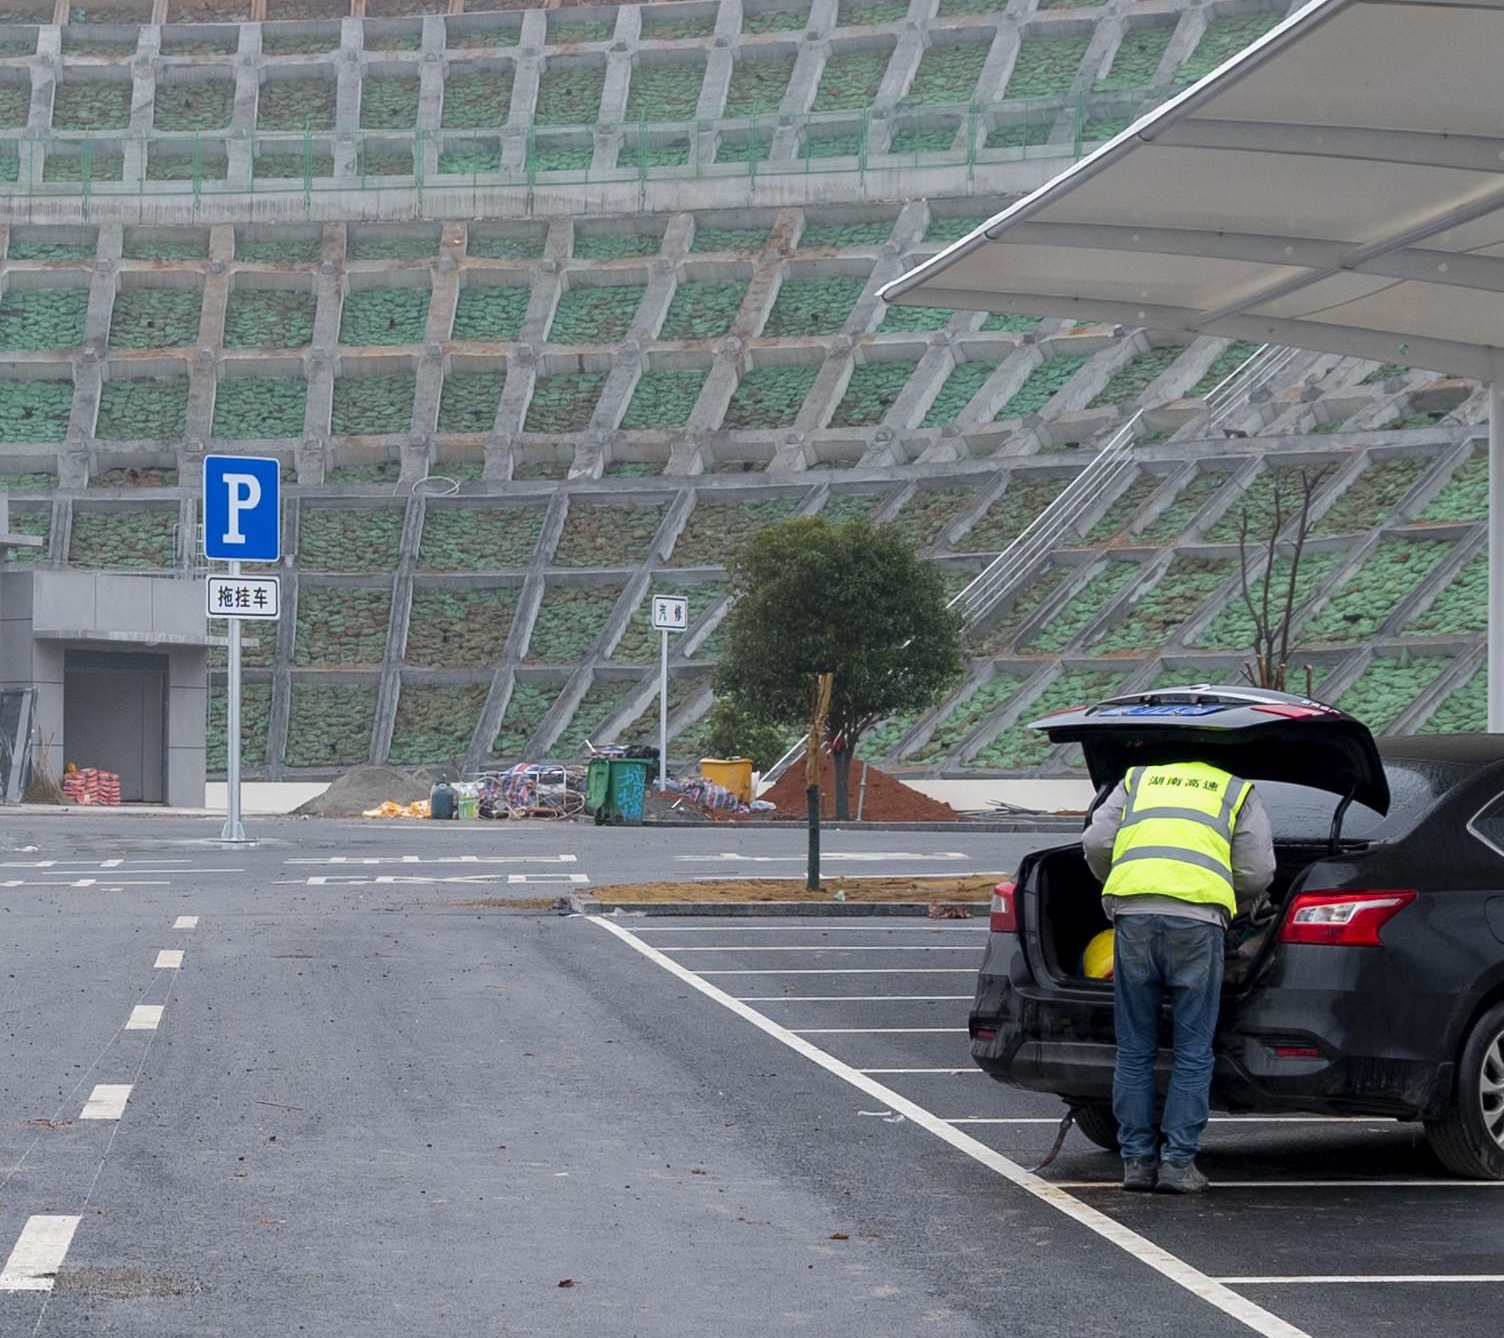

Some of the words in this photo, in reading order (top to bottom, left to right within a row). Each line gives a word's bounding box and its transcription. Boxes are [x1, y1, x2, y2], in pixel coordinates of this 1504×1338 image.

[222, 473, 262, 544] P
[218, 586, 268, 609] 拖挂车
[1148, 776, 1219, 792] 湖南高速
